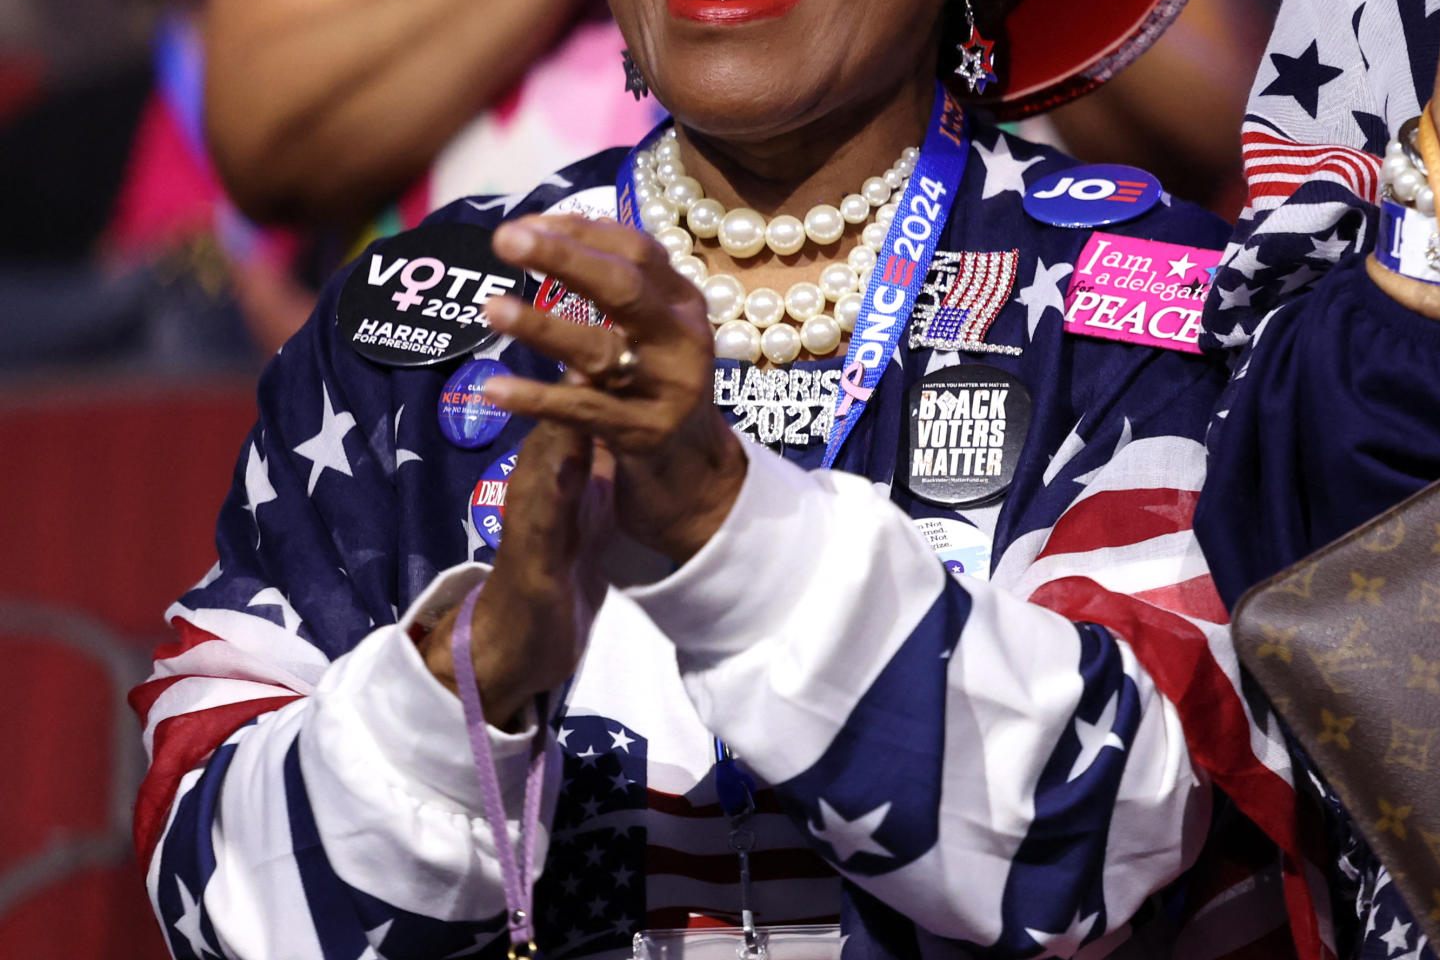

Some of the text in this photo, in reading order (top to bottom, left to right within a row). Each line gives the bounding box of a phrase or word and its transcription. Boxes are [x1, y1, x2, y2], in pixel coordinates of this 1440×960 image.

[1033, 177, 1148, 203] JOE
[853, 175, 947, 370] DNC 2024
[1079, 240, 1153, 275] I am
[367, 253, 517, 312] VOTE
[1066, 280, 1095, 298] for
[1095, 272, 1109, 285] a
[421, 298, 491, 329] 2024
[1063, 291, 1205, 344] PEACE
[352, 332, 446, 357] FOR PRESIDENT
[358, 318, 453, 350] HARRIS
[713, 366, 842, 406] HARRIS
[732, 397, 835, 445] 2024
[917, 419, 1007, 448] VOTERS
[911, 448, 1003, 477] MATTER
[477, 480, 508, 507] DEM
